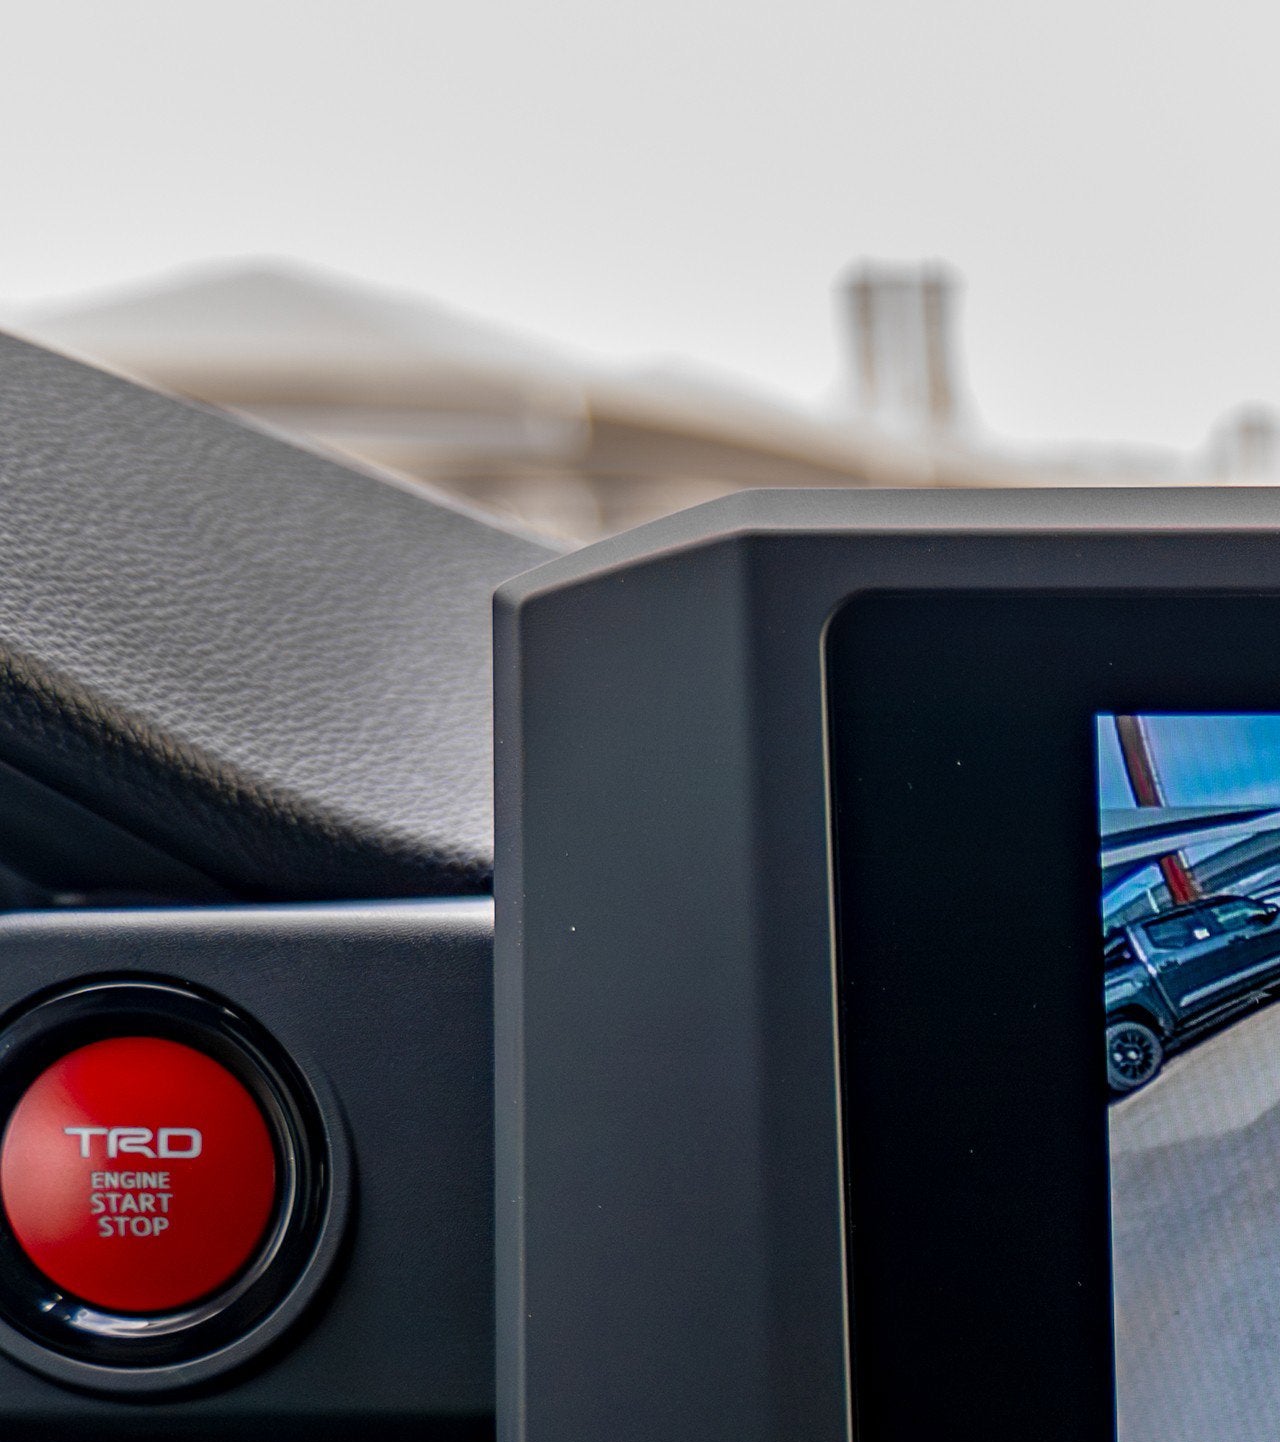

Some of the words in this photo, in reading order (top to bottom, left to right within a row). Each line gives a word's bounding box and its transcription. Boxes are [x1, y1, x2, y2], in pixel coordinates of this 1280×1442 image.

[64, 1127, 202, 1159] TRD
[91, 1172, 170, 1189] ENGINE
[90, 1193, 173, 1214] START
[98, 1216, 169, 1237] STOP
